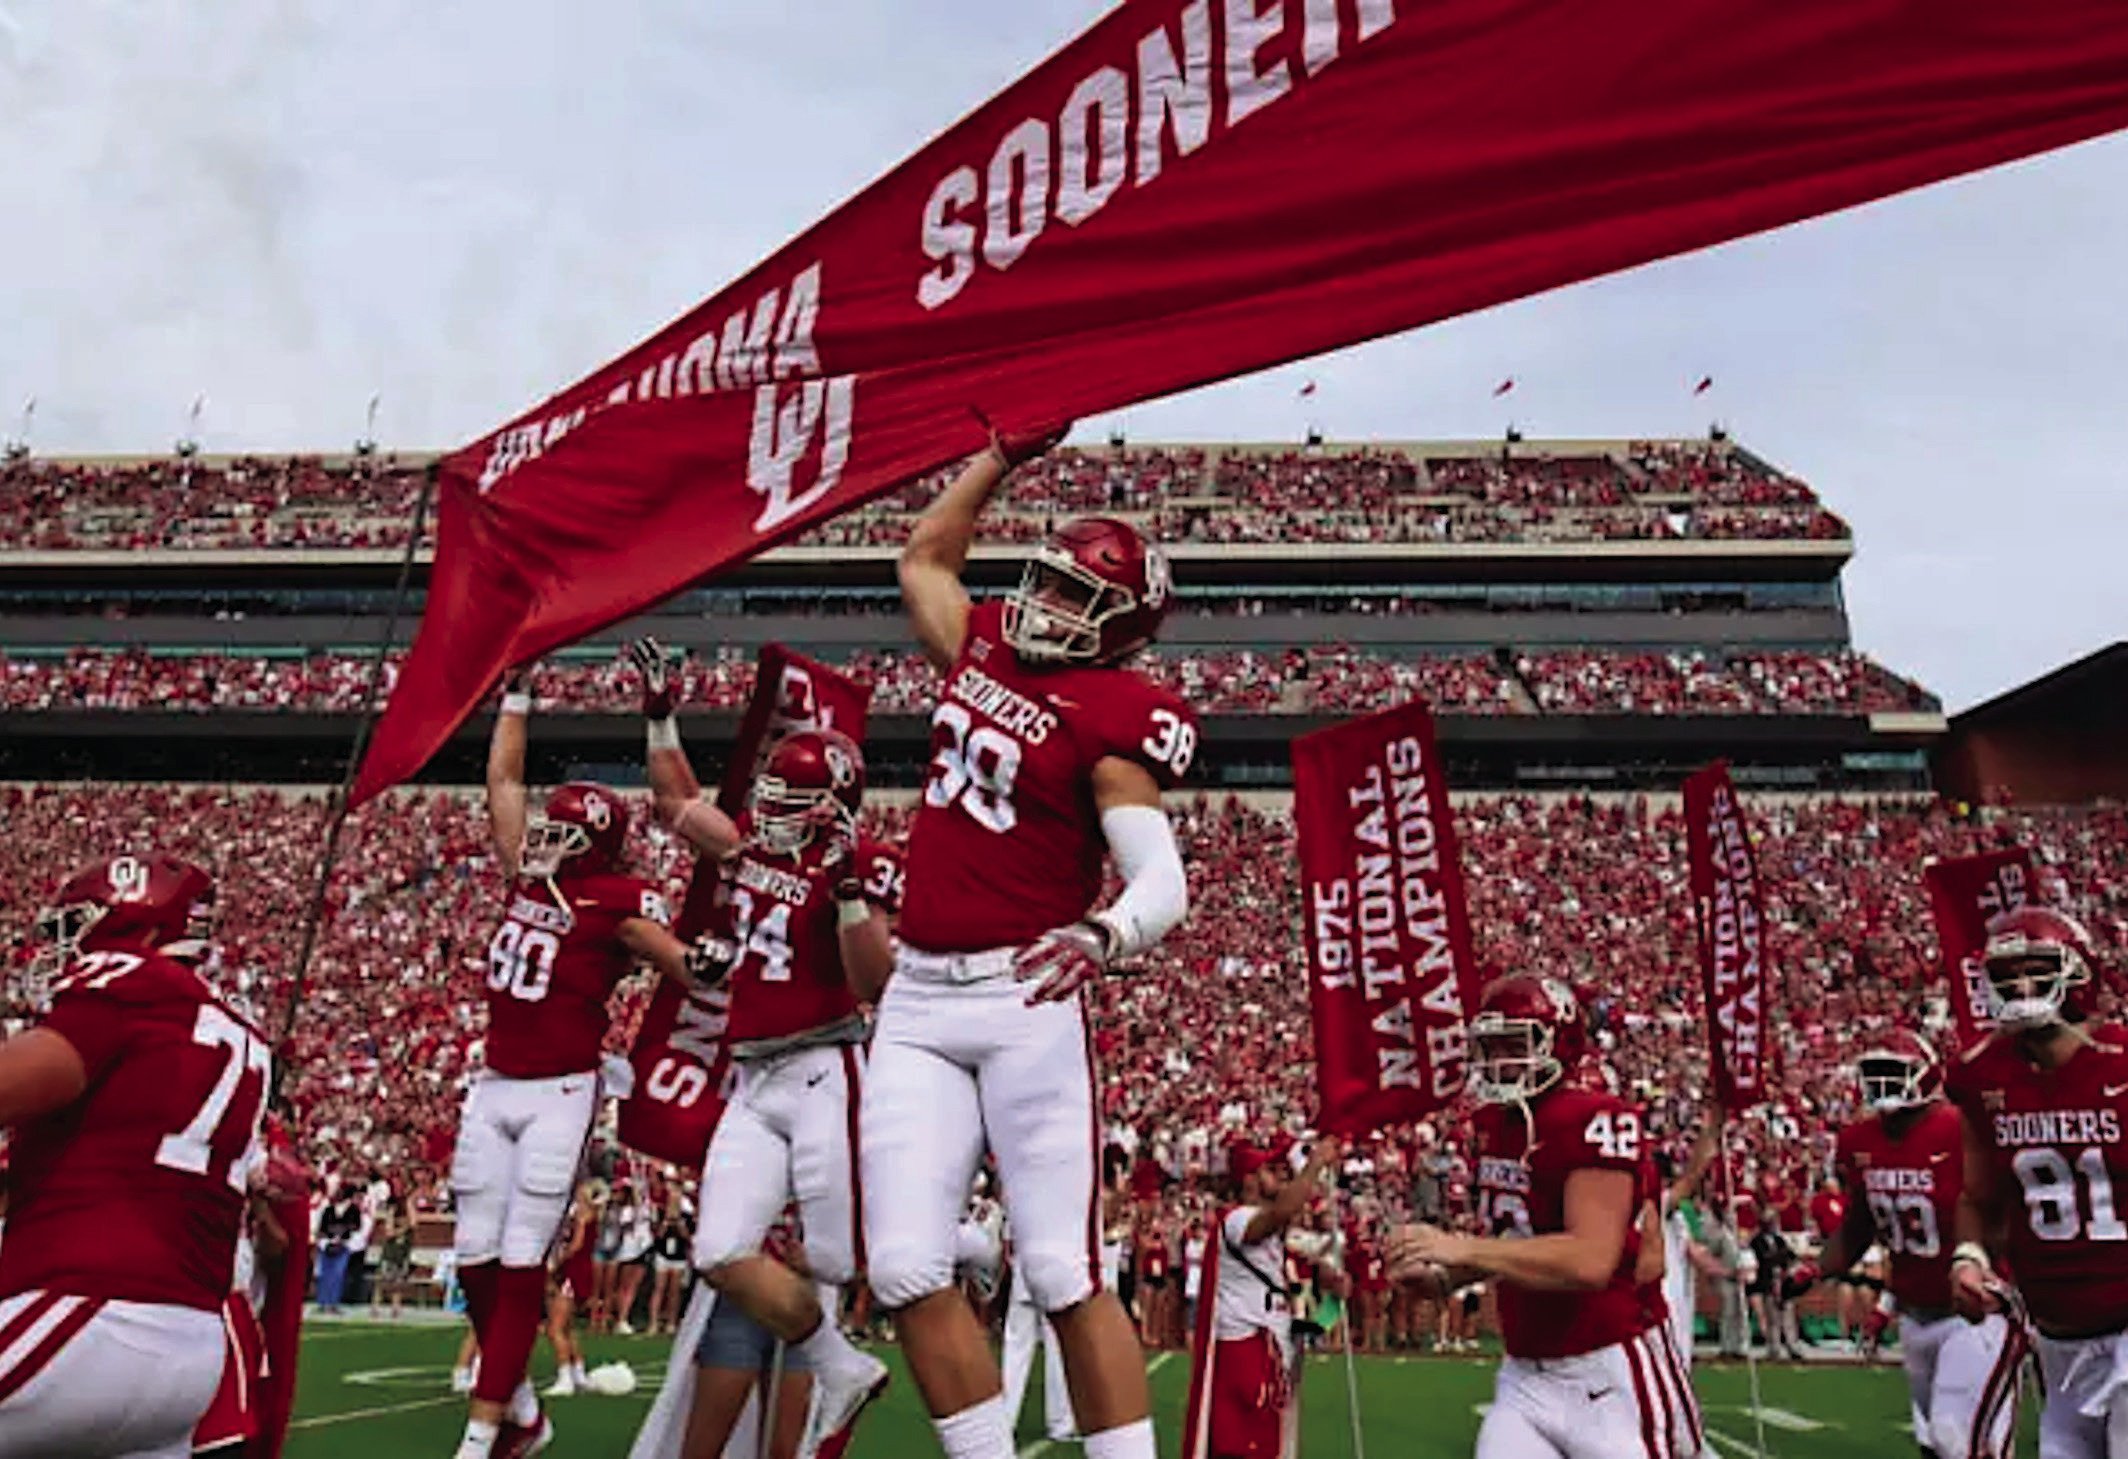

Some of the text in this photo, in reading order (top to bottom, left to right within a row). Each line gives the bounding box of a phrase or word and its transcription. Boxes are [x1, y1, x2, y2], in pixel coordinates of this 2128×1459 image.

[925, 701, 1022, 834] 38
[1142, 708, 1197, 777] 38
[486, 920, 560, 1002] 80
[1312, 878, 1357, 991] 1975
[1349, 764, 1422, 1091] NATIONAL
[1386, 736, 1469, 1099] CHAMPIONS
[1584, 1109, 1642, 1162] 42
[1993, 1107, 2121, 1147] SOONERS
[2011, 1146, 2128, 1241] 81
